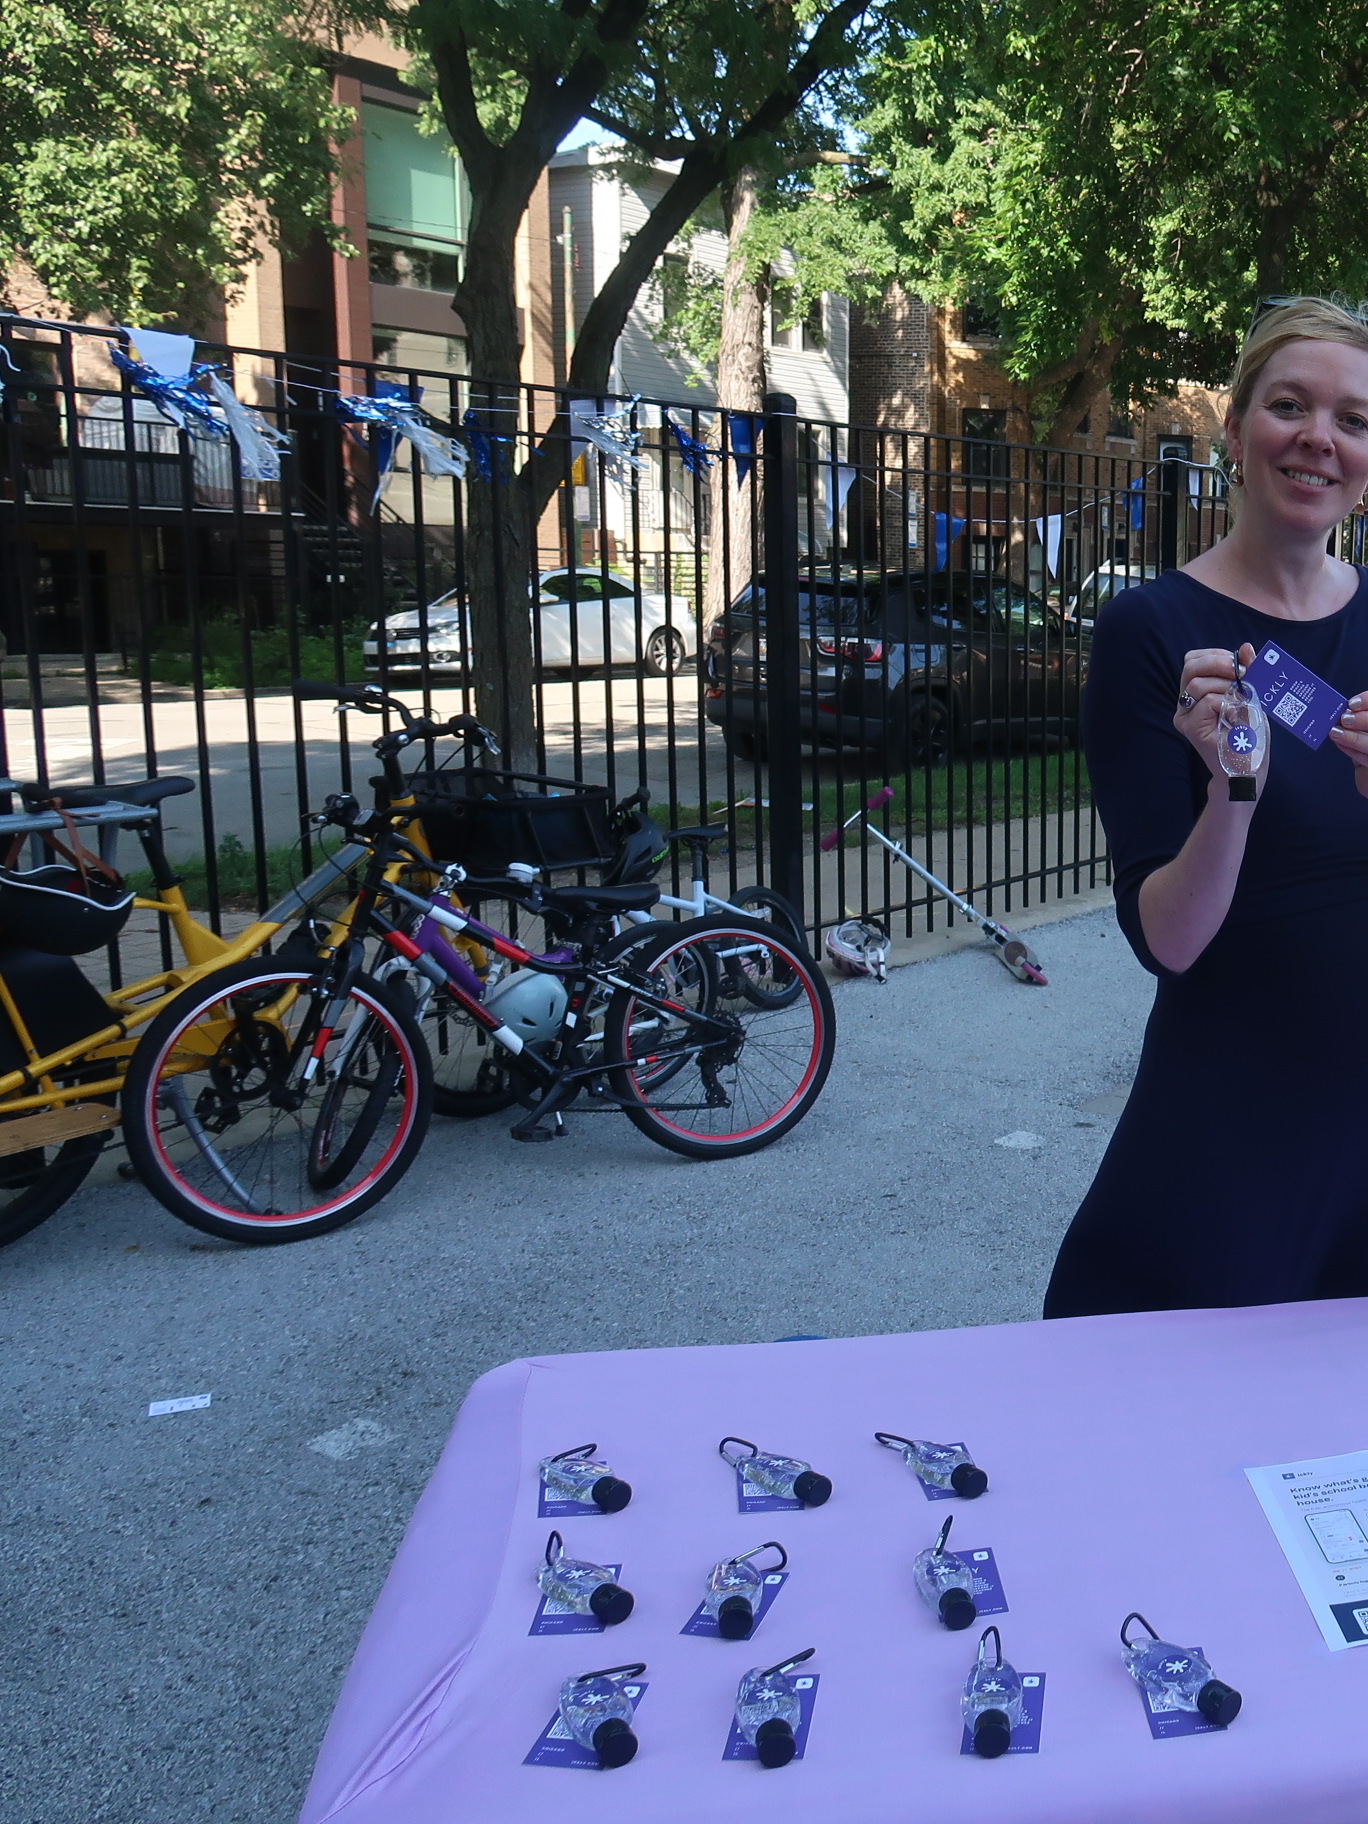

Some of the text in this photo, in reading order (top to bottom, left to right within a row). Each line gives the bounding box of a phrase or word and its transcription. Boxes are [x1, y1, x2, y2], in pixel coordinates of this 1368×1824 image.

[1260, 671, 1288, 707] ICKLY
[1290, 1484, 1321, 1493] Know
[1321, 1486, 1357, 1496] school
[1296, 1497, 1334, 1507] house.
